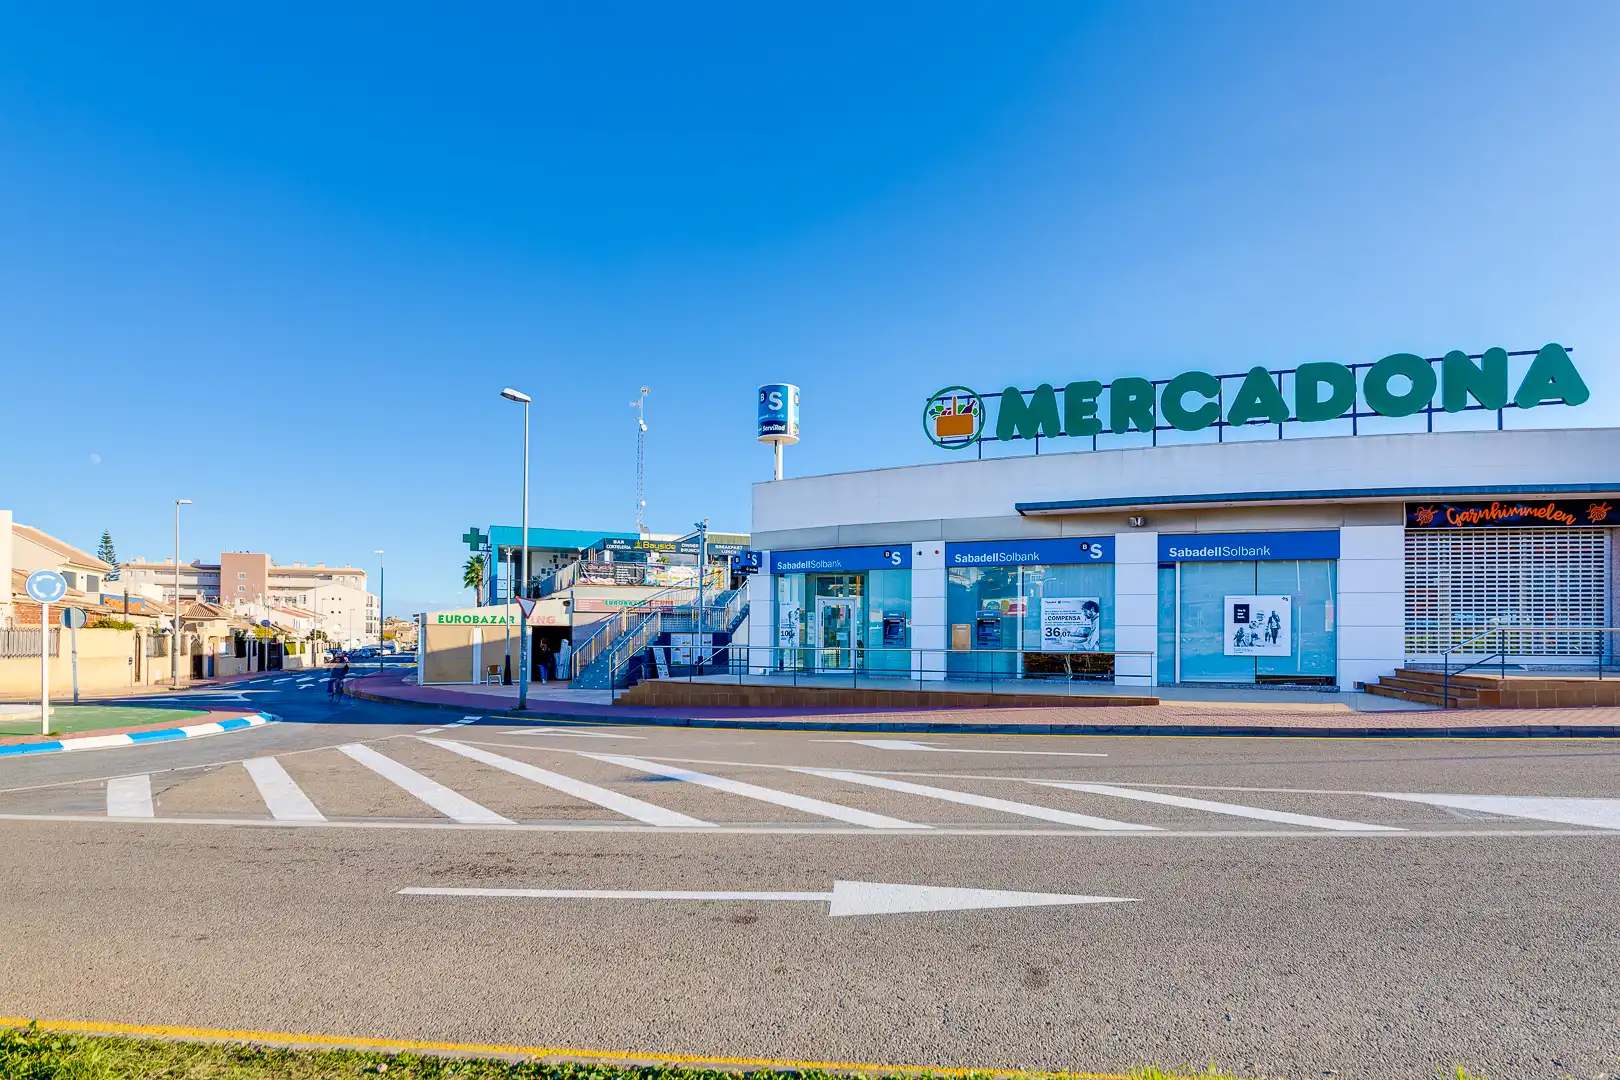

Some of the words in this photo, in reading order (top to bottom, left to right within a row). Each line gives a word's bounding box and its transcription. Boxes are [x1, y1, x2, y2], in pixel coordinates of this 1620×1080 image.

[996, 343, 1590, 439] MERCADONA
[768, 391, 783, 411] S
[1446, 501, 1577, 527] Garnhimmelen
[643, 541, 677, 551] Bayside
[1089, 543, 1103, 559] S
[1169, 546, 1271, 557] SabadellSolbank
[891, 551, 902, 565] S
[954, 552, 1040, 563] SabadellSolbank
[777, 559, 842, 570] SabadellSolbank
[438, 614, 515, 624] EUROBAZAR
